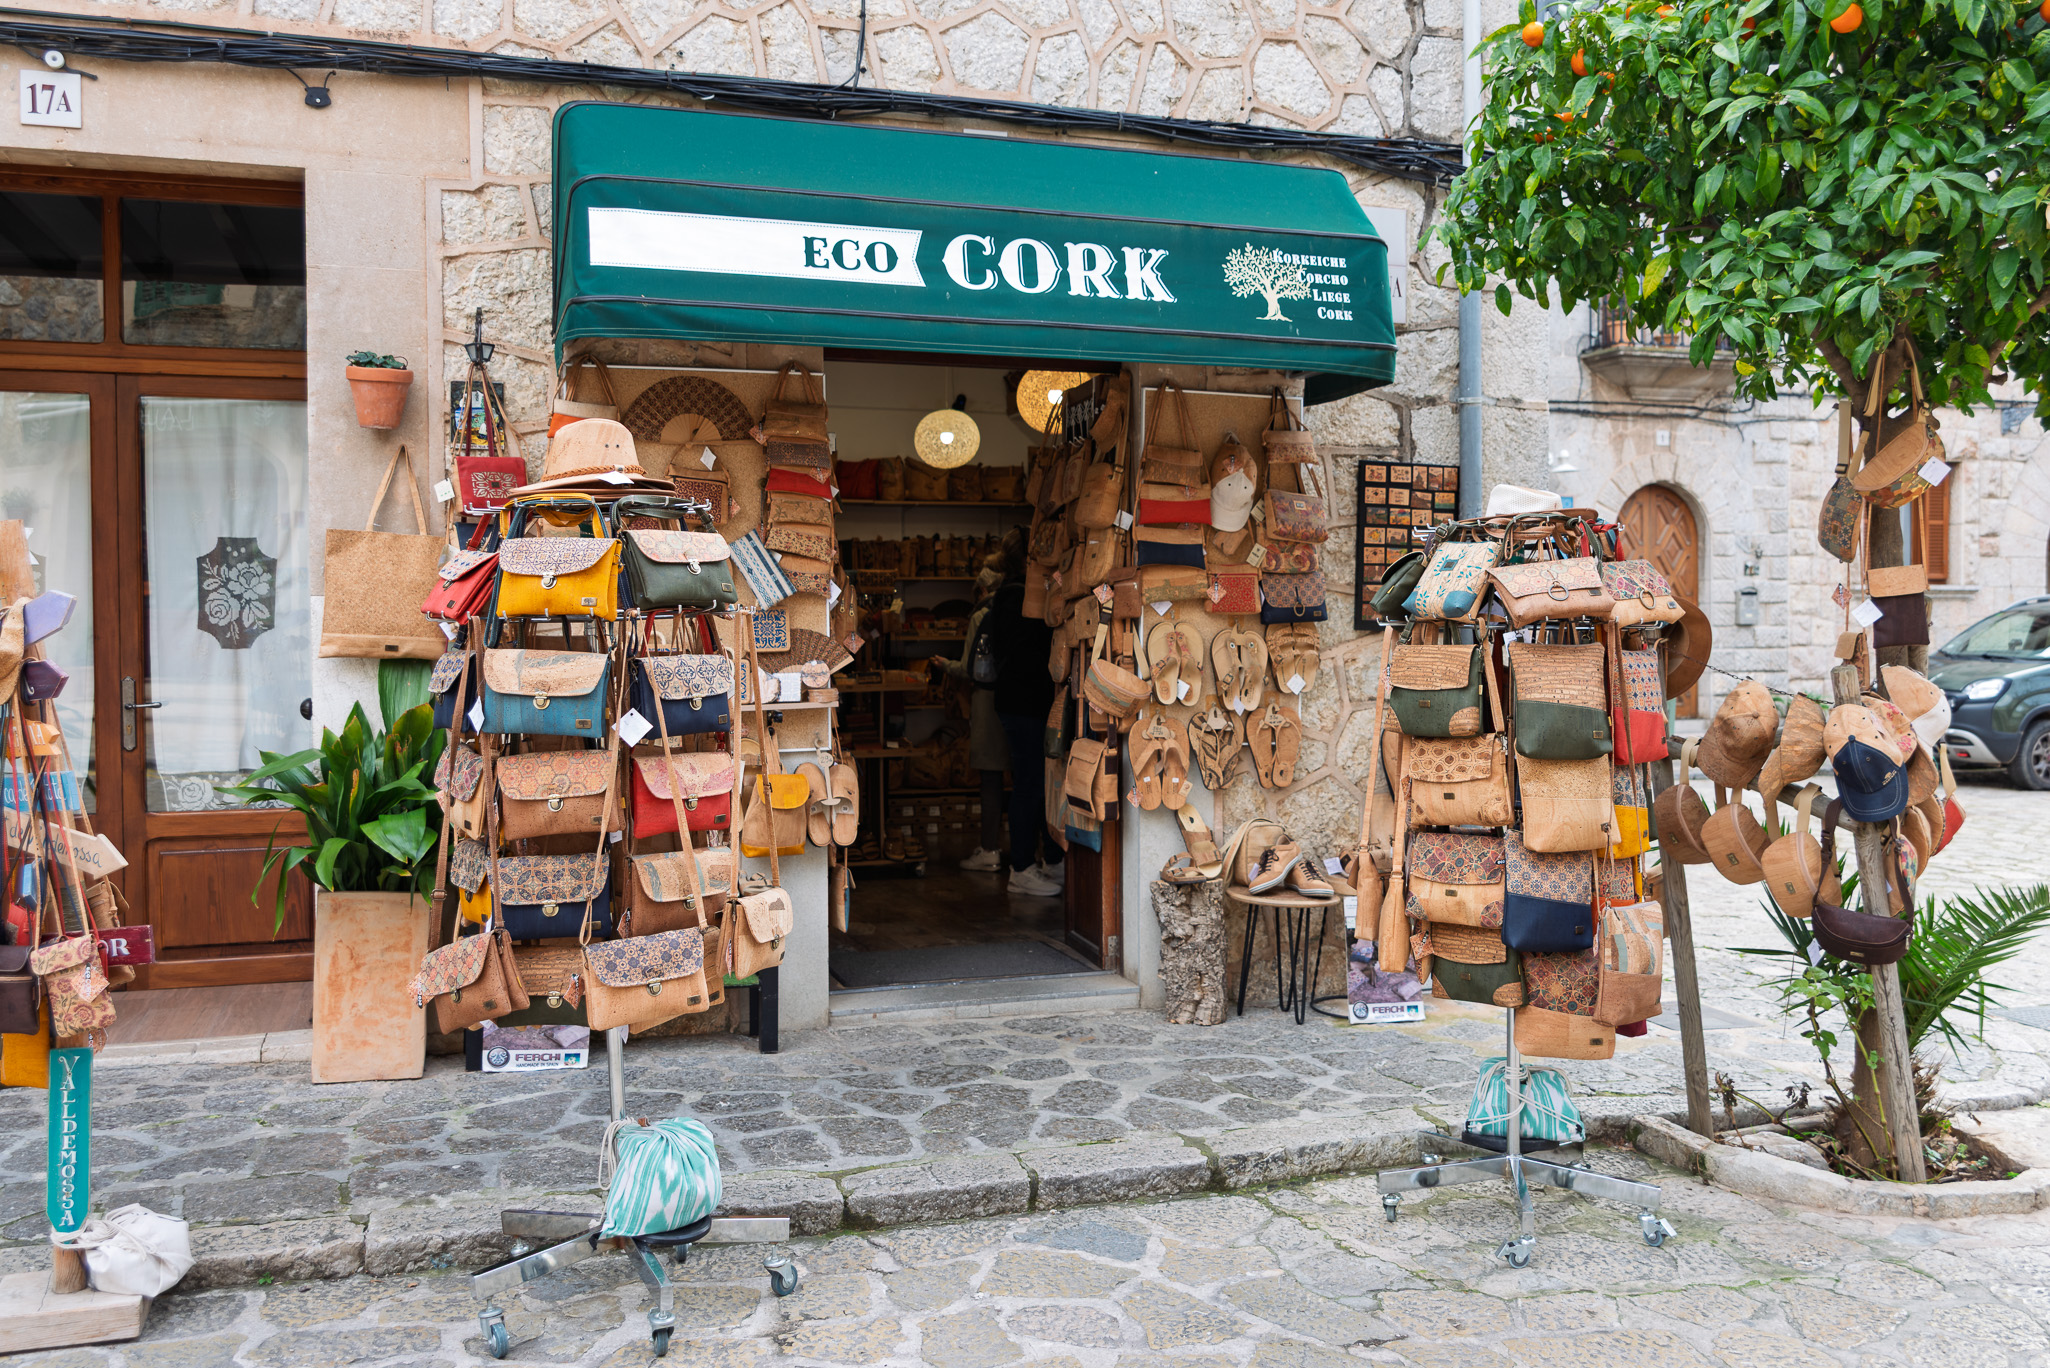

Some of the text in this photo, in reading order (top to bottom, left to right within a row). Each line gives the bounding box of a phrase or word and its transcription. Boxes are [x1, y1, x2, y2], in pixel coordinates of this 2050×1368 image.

[26, 83, 73, 115] 17A
[1272, 249, 1347, 268] KORKEICHE
[803, 233, 1178, 304] ECO CORK
[1297, 270, 1349, 286] CORCHO
[1312, 288, 1351, 303] LIEGE
[1317, 306, 1354, 321] CORK
[1372, 1005, 1405, 1014] FERCHI
[515, 1053, 561, 1062] FERCHI
[56, 1055, 81, 1227] VALLDEMOSSA
